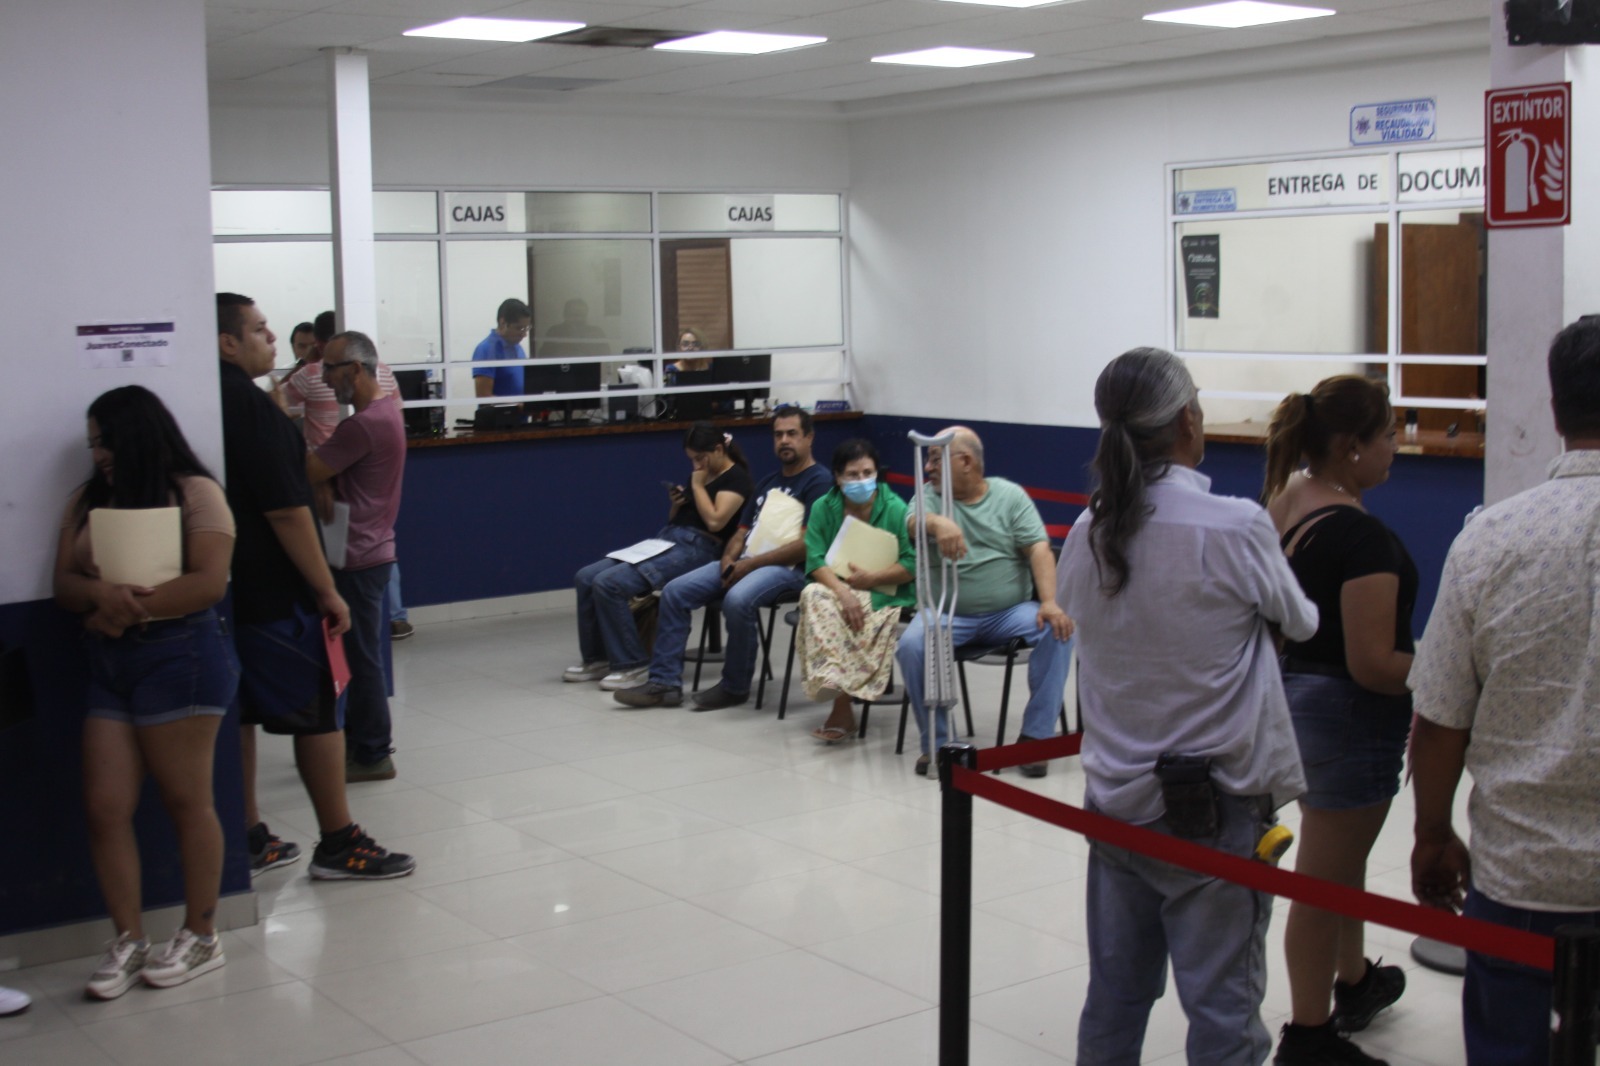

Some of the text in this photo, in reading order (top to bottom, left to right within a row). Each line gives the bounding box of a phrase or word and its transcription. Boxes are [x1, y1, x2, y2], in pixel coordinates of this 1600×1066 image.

[1492, 96, 1563, 124] EXTINTOR
[1381, 128, 1424, 141] VIALIDAD
[1268, 166, 1486, 196] ENTREGA DE DOCUM
[452, 205, 505, 222] CAJAS
[728, 206, 773, 222] CAJAS
